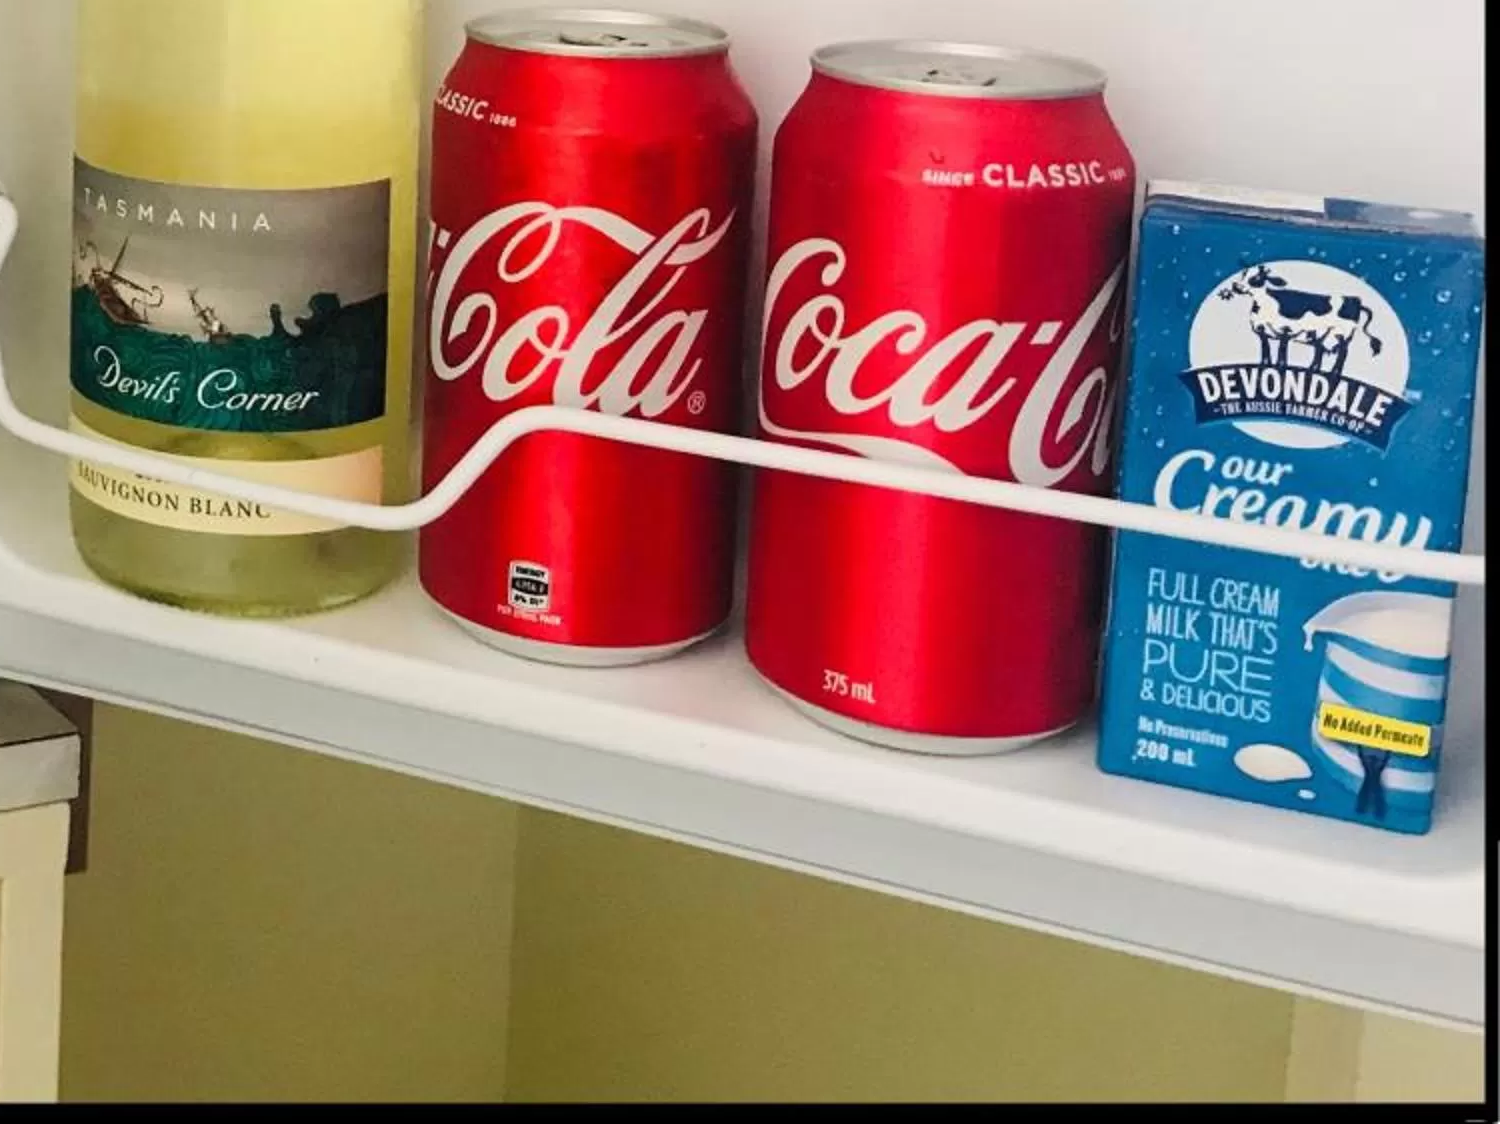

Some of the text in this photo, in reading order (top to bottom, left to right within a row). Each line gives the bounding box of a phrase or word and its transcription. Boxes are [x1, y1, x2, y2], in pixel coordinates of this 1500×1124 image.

[982, 160, 1105, 189] CLASSIC
[82, 186, 273, 232] TASMANIA
[93, 344, 321, 413] Devil's Corner
[1197, 364, 1393, 429] DEVONDALE
[1245, 401, 1282, 415] AUSSIE
[78, 459, 181, 512] SAUVIGNON
[1221, 454, 1294, 487] our
[1148, 567, 1281, 618] FULL CREAM
[1146, 603, 1279, 655] MILK THAT'S
[822, 669, 877, 705] 375 mL
[1143, 639, 1276, 698] PURE
[1140, 678, 1272, 724] & DELICIOUS
[1340, 717, 1373, 738] Added
[1137, 738, 1198, 768] 200 mL
